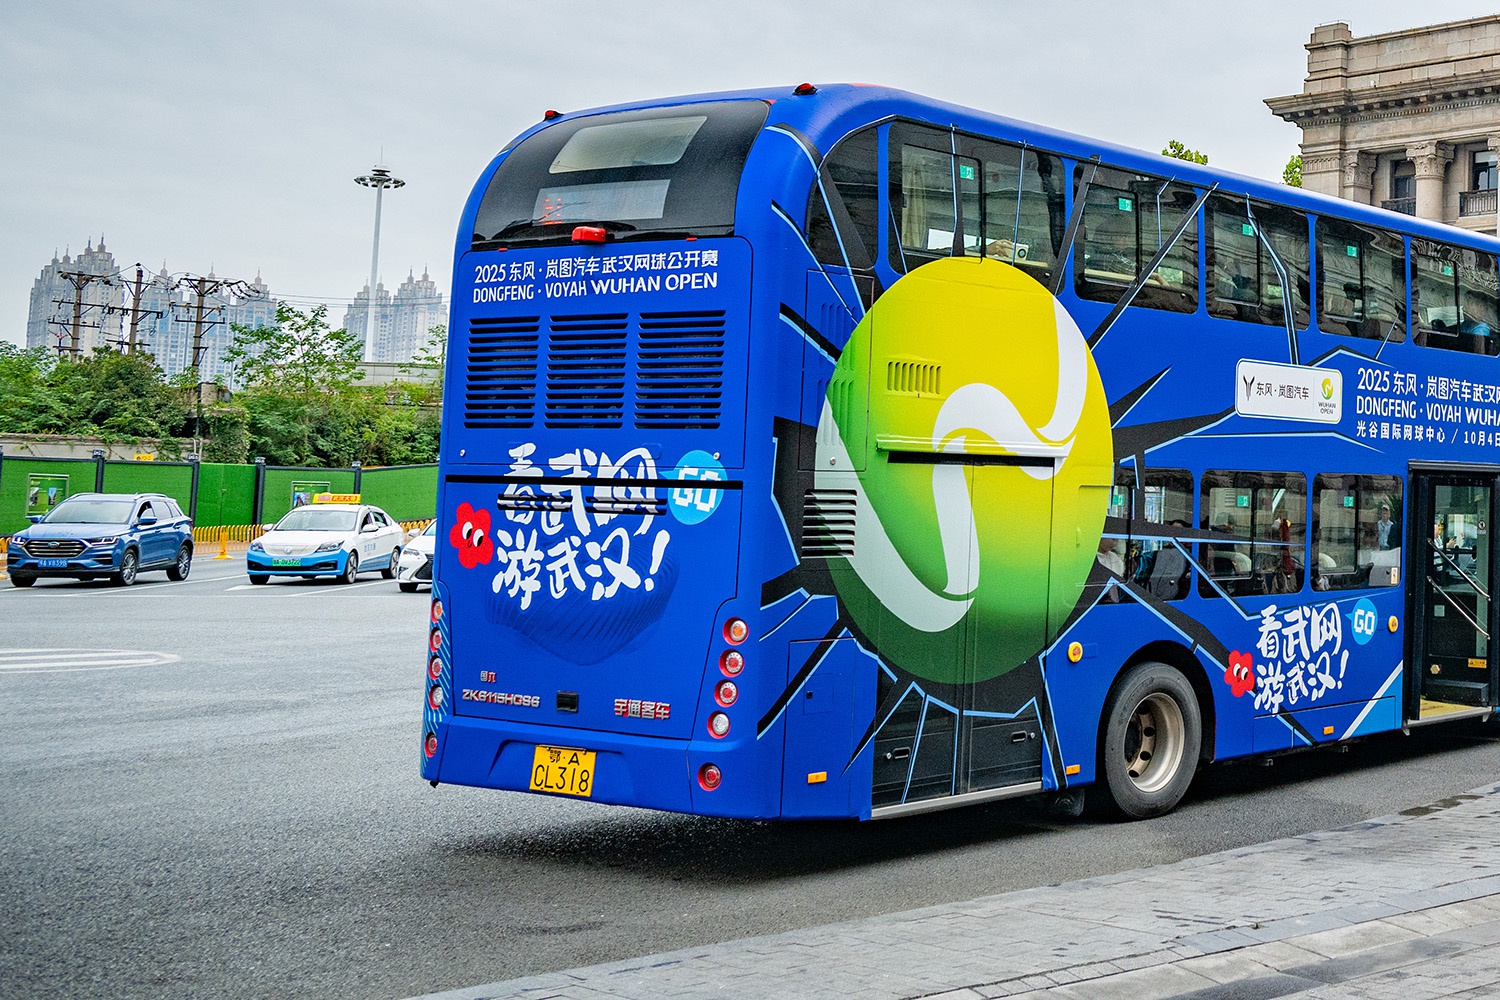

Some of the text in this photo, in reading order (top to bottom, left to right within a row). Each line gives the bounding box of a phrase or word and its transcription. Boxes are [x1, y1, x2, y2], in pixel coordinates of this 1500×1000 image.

[475, 264, 506, 284] 2025
[473, 272, 717, 303] DONGFENG VOYAH WUHAN OPEN
[1357, 368, 1390, 392] 2025
[1356, 396, 1416, 419] DONGFENG
[1426, 403, 1462, 423] VOYAH
[1356, 420, 1446, 443] 光谷国际网球中心
[672, 465, 722, 512] GO
[1256, 602, 1375, 663] 看武网 GO
[480, 670, 497, 683] 国六
[613, 698, 671, 720] 宇通客车
[534, 764, 590, 793] CL318
